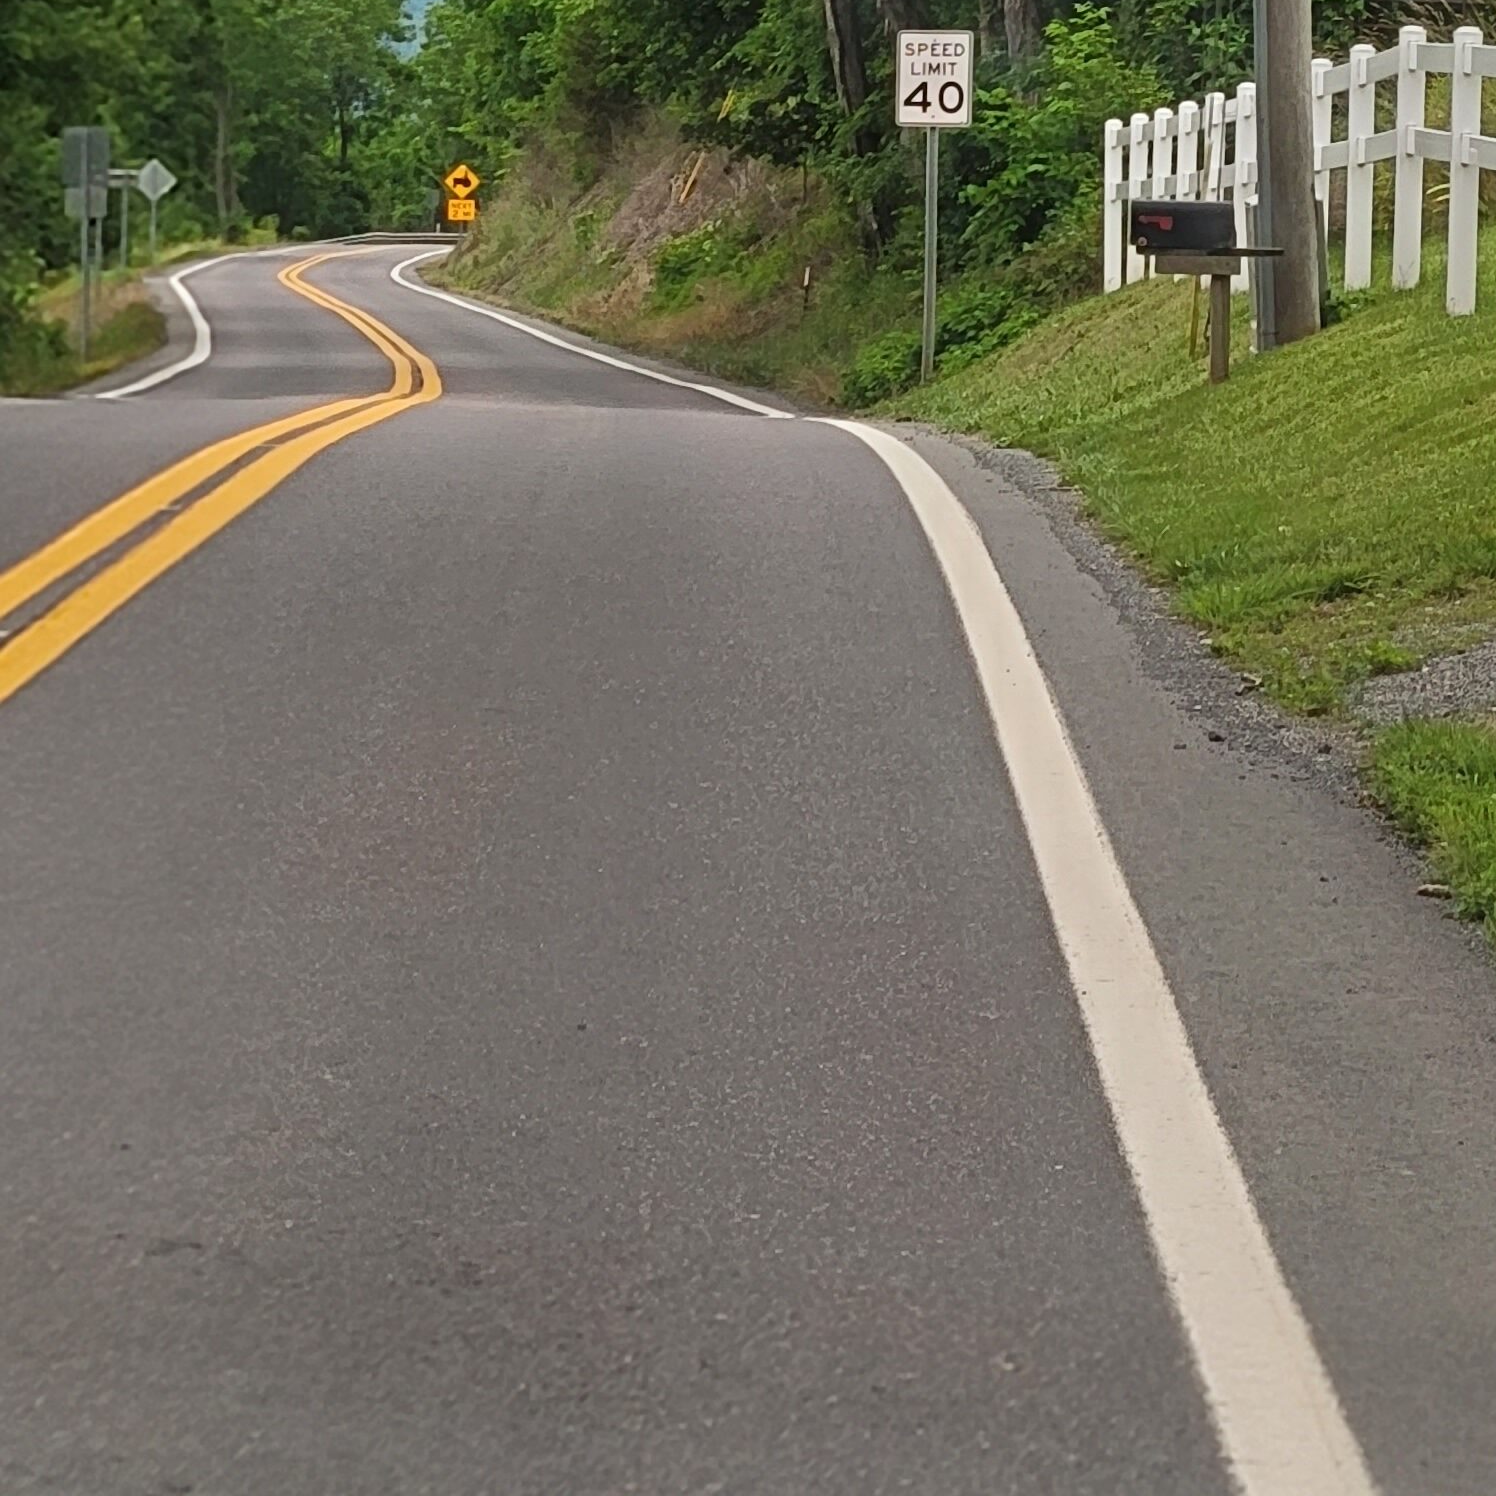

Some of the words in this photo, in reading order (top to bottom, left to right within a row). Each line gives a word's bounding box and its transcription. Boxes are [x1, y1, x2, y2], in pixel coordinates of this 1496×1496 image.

[905, 42, 965, 57] SPEED
[910, 62, 957, 76] LIMIT
[903, 81, 964, 113] 40
[452, 209, 459, 218] 2
